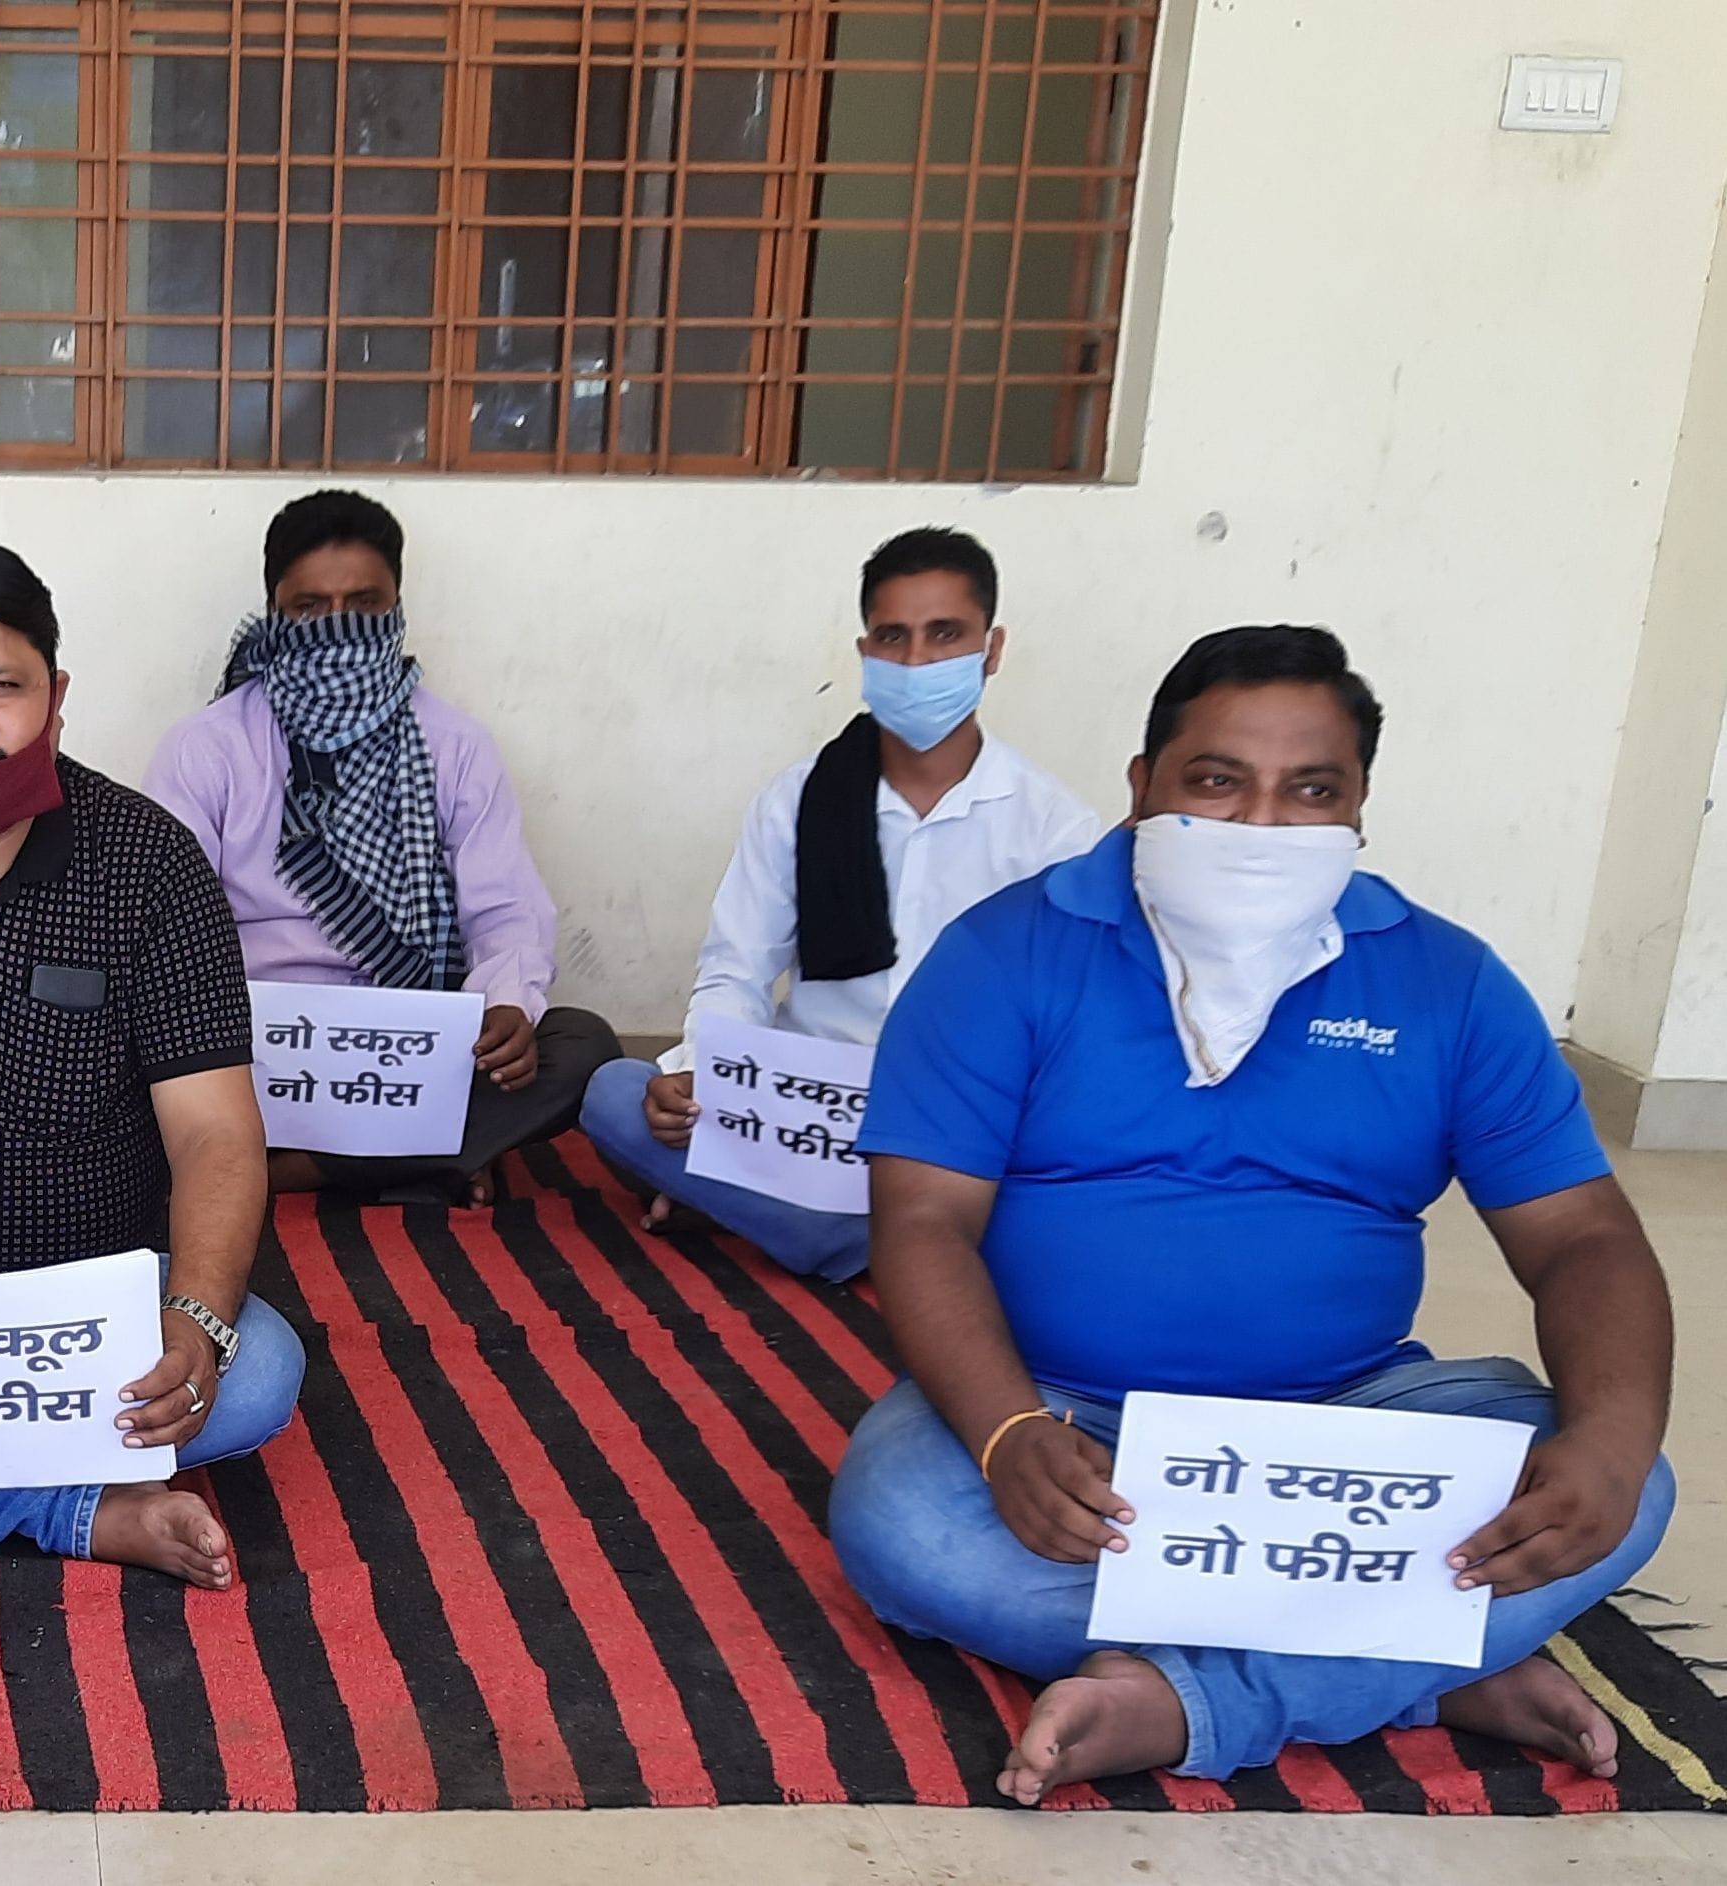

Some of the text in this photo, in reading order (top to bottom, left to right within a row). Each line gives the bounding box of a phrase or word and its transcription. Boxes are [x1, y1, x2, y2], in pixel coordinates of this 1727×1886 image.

[266, 1015, 440, 1066] नो स्कूल
[267, 1070, 423, 1107] नो फीस
[712, 1055, 763, 1089] नो
[717, 1109, 764, 1142] नो
[1166, 1446, 1451, 1525] नो स्कूल
[1164, 1525, 1415, 1582] नो फीस
